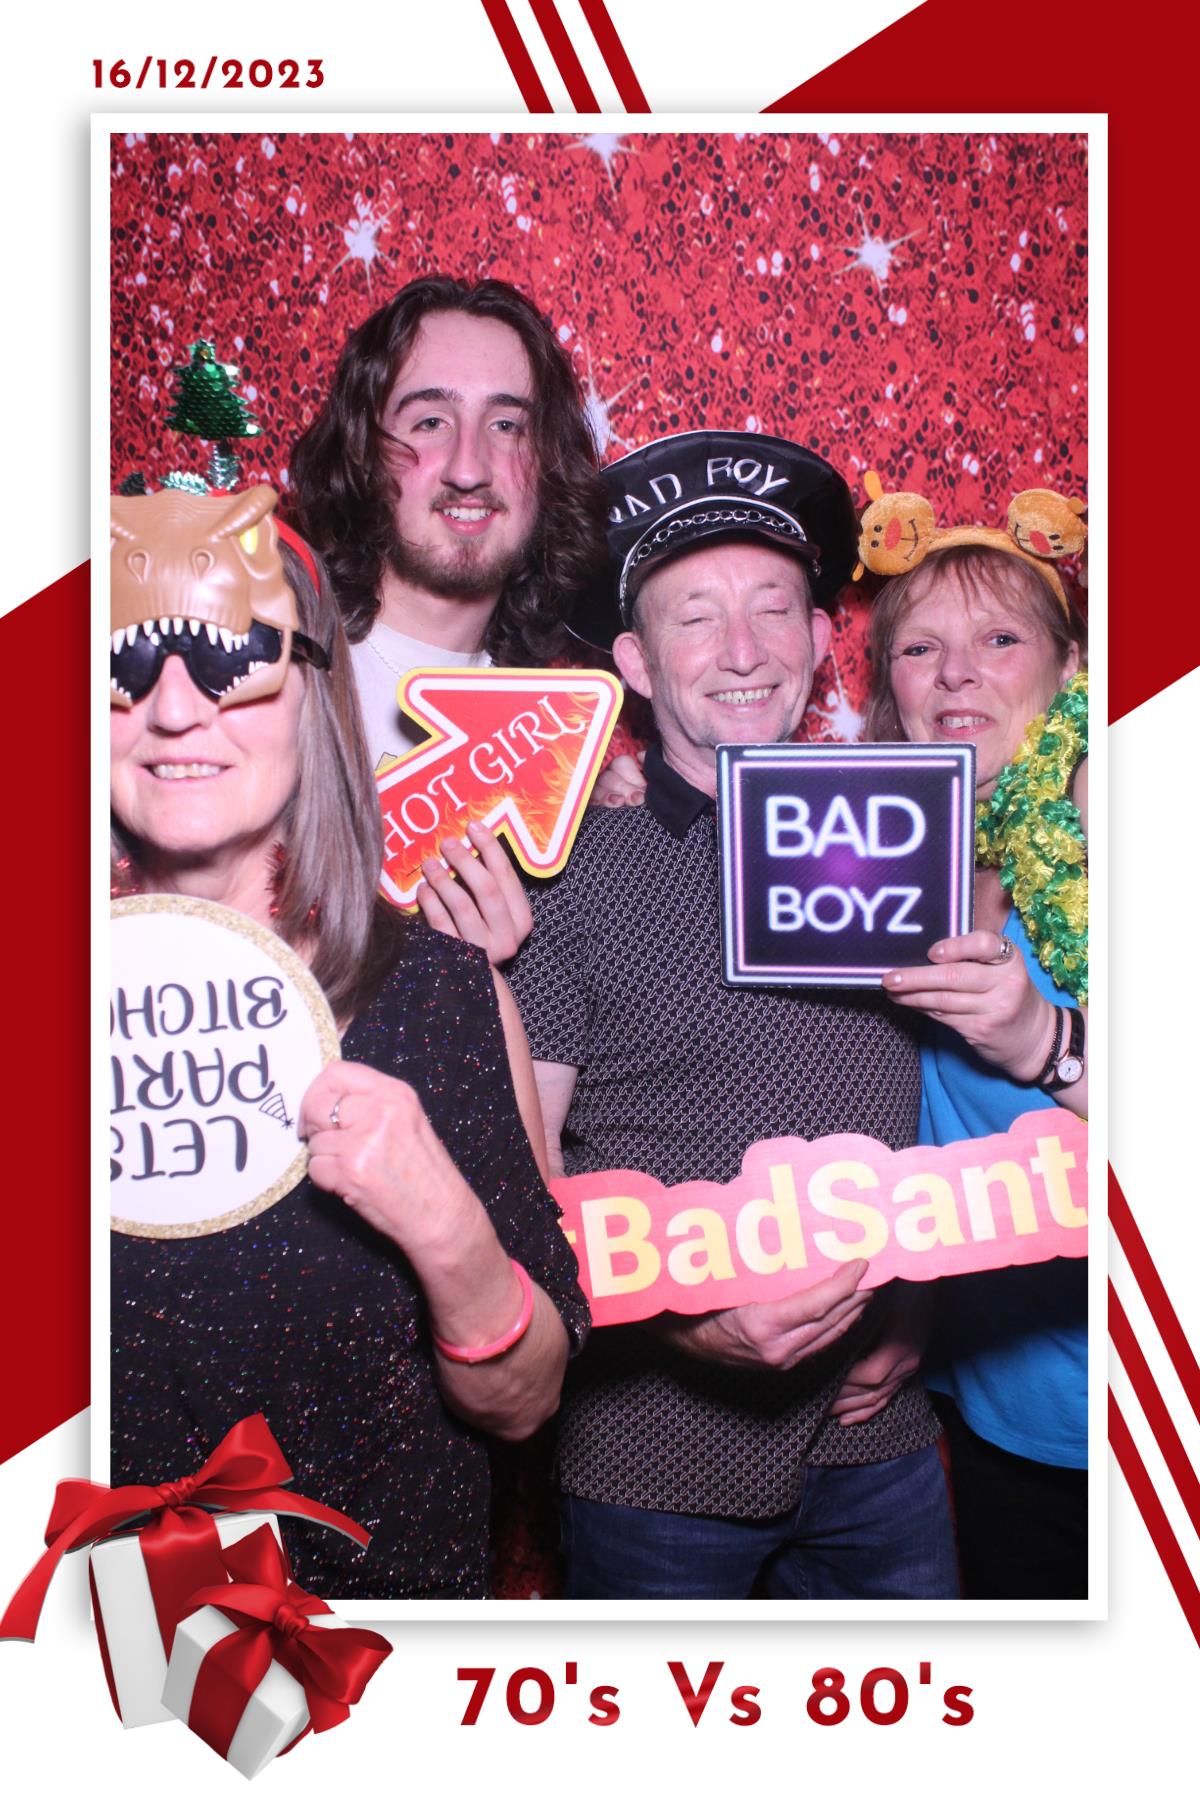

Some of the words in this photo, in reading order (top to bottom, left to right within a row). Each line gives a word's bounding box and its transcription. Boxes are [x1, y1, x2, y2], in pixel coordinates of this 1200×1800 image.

[383, 765, 467, 862] HOT
[468, 695, 586, 785] GIRL
[764, 794, 927, 858] BAD
[767, 885, 923, 933] BOYZ
[110, 976, 287, 1039] BITCH
[557, 1135, 1088, 1299] BadSant
